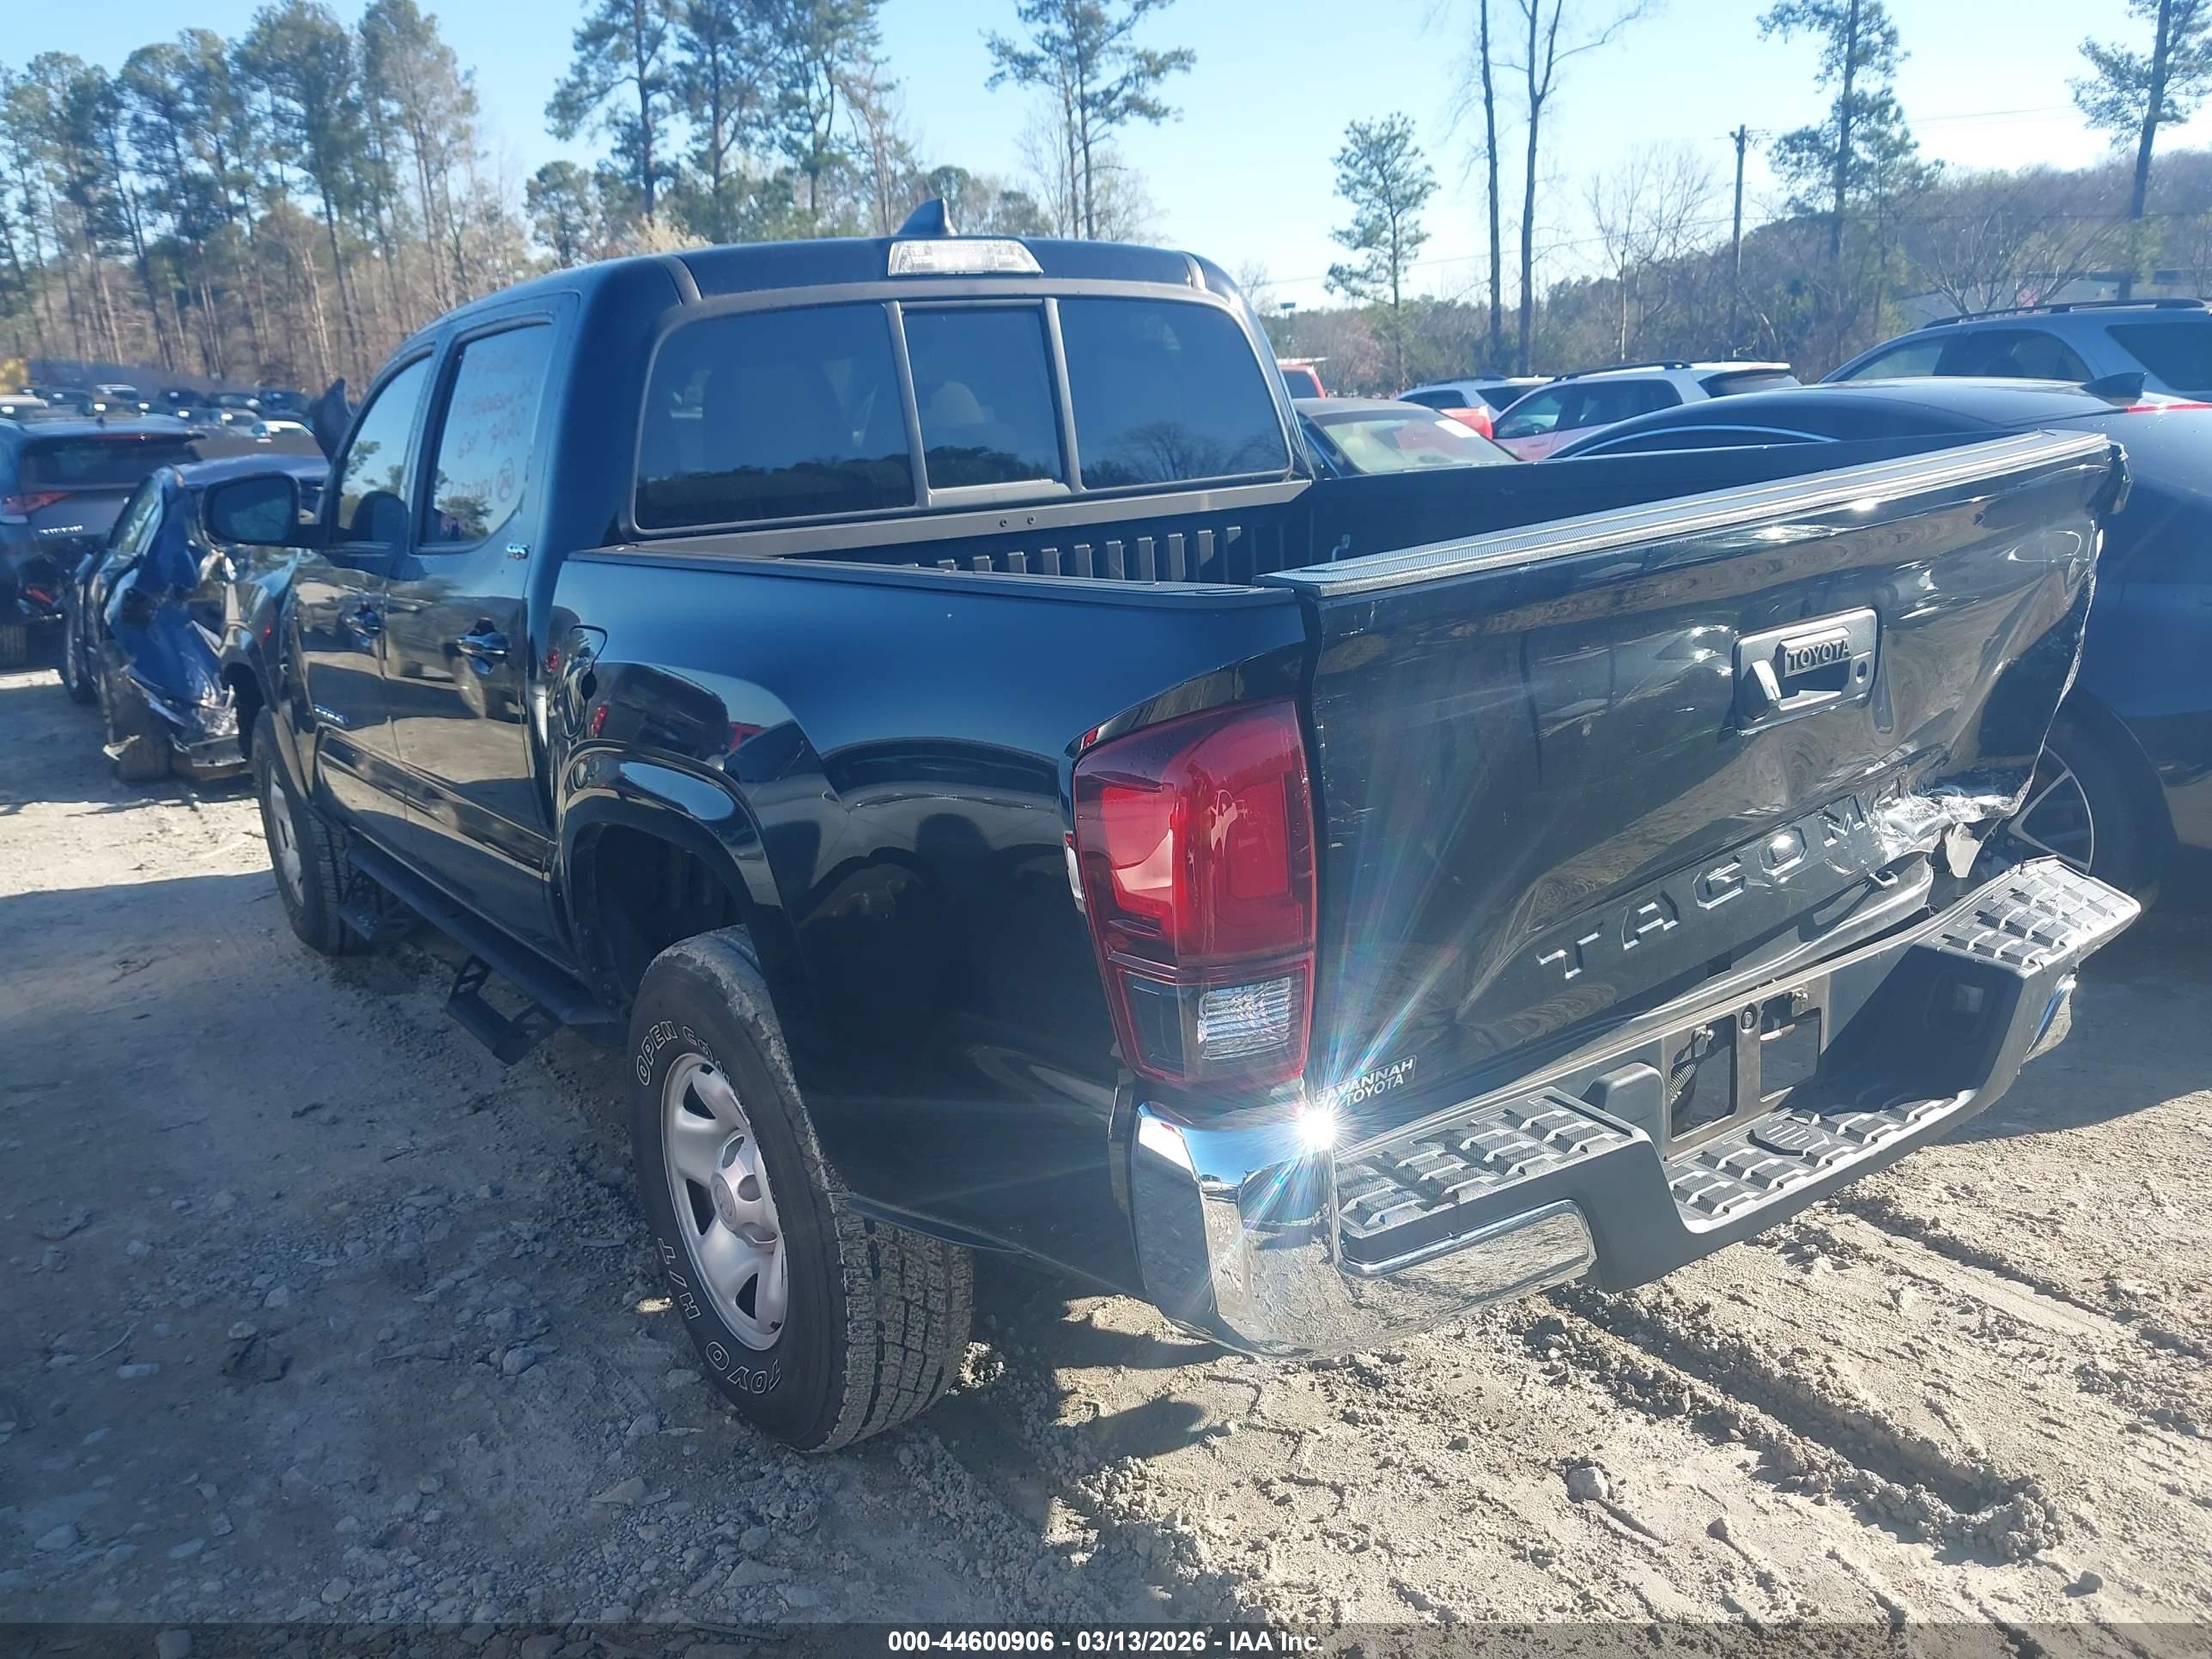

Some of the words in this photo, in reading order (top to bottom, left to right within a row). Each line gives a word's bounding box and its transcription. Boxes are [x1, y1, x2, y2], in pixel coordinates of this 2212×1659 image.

[1787, 638, 1851, 671] TOYOTA
[1535, 792, 1899, 980] TACOM
[636, 1021, 678, 1085] OPEN
[1316, 1058, 1413, 1103] SAVANNAH
[1344, 1075, 1404, 1108] TOYOTA
[707, 1341, 781, 1394] TOYO
